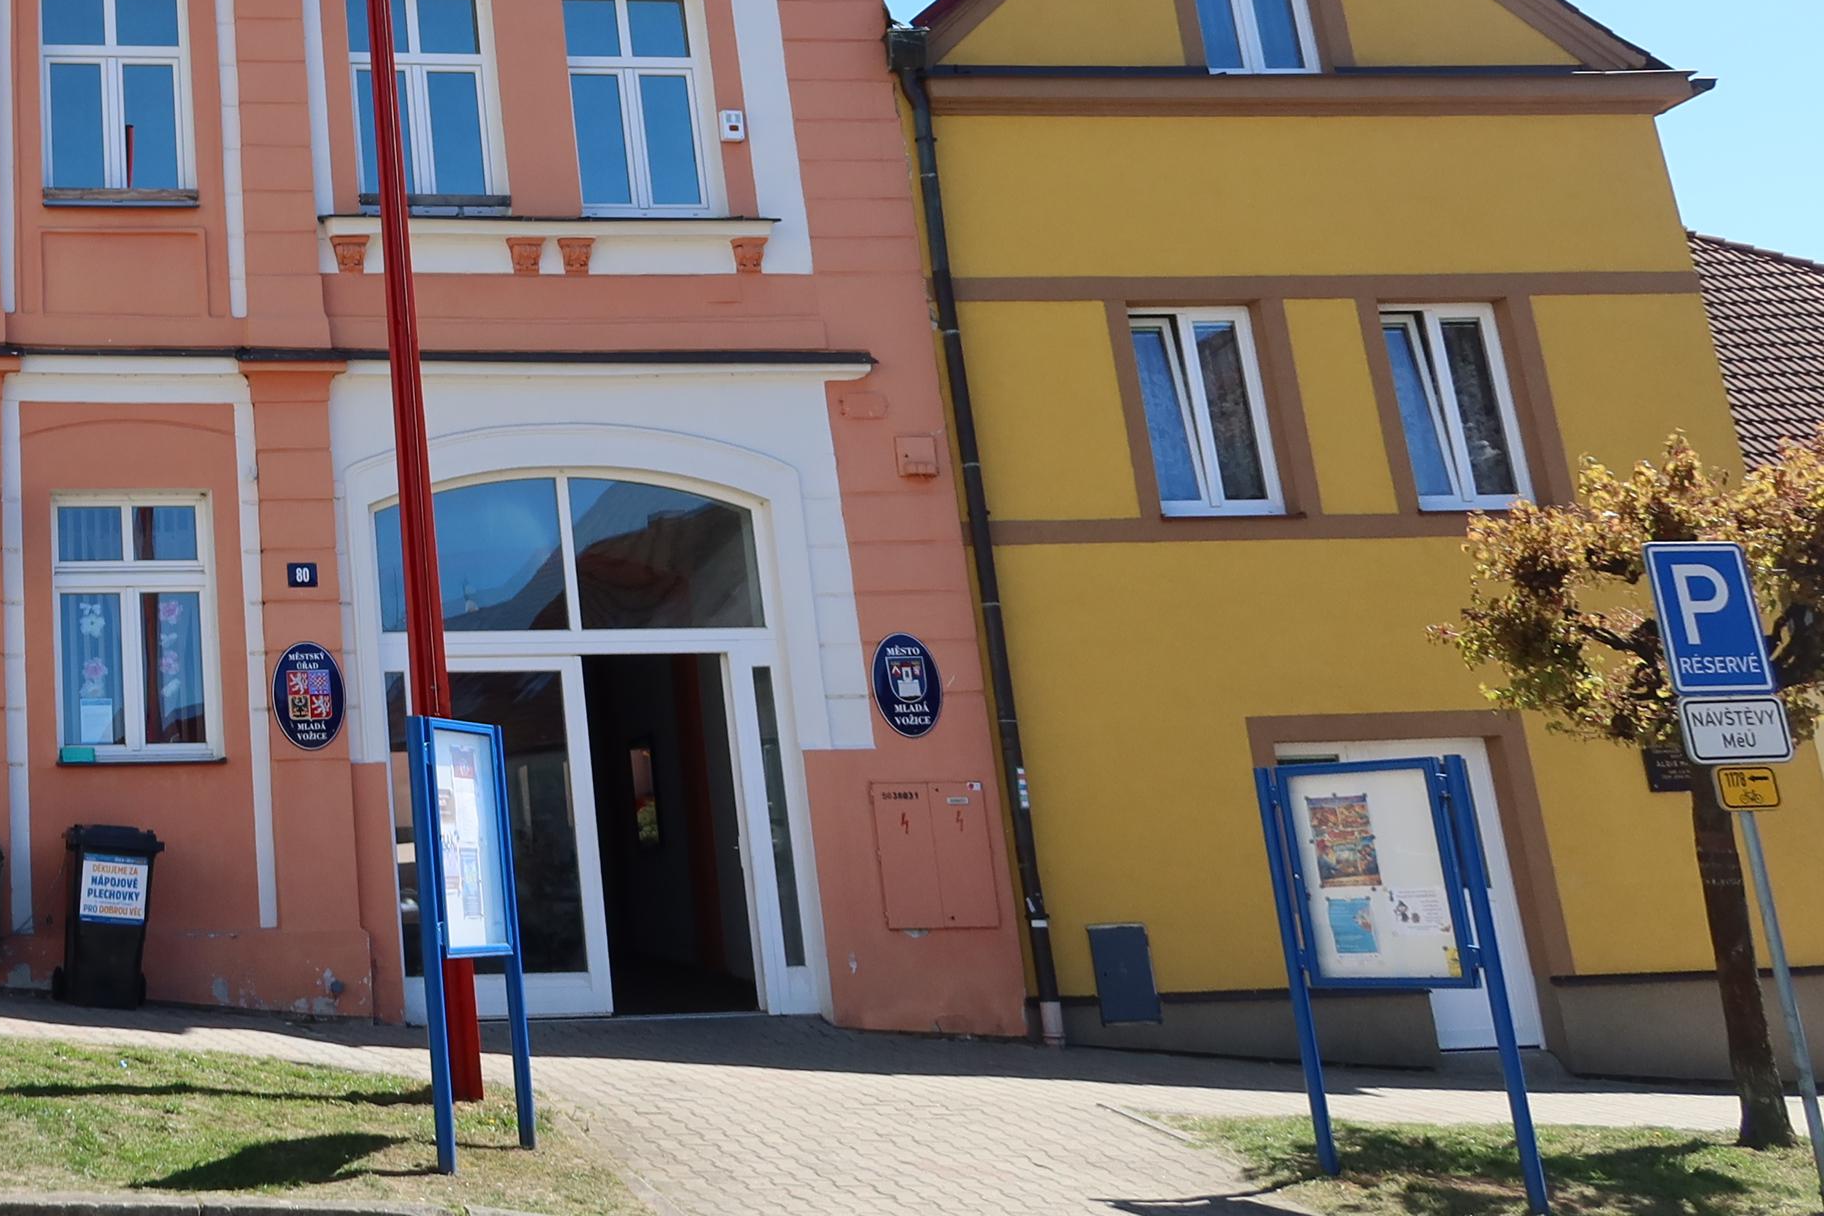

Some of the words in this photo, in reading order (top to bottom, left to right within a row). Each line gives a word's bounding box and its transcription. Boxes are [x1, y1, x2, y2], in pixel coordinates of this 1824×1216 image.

[295, 567, 310, 583] 80
[1670, 564, 1729, 645] P
[288, 651, 325, 661] MĚSTSKÝ
[886, 645, 921, 656] MĚSTO
[1680, 652, 1761, 674] RÉSERVÉ
[894, 701, 929, 713] MLADÁ
[894, 713, 932, 726] VOŽICE
[1690, 706, 1776, 728] NÁVŠTĚVY
[297, 720, 326, 731] MLADÁ
[296, 730, 328, 741] VOŽICE
[1722, 729, 1757, 749] MěÚ
[129, 866, 139, 876] ZA
[91, 874, 138, 889] NÁPOJOVÉ
[87, 888, 140, 902] PLECHOVKY
[83, 904, 98, 914] PRO
[99, 905, 128, 916] DOBROU
